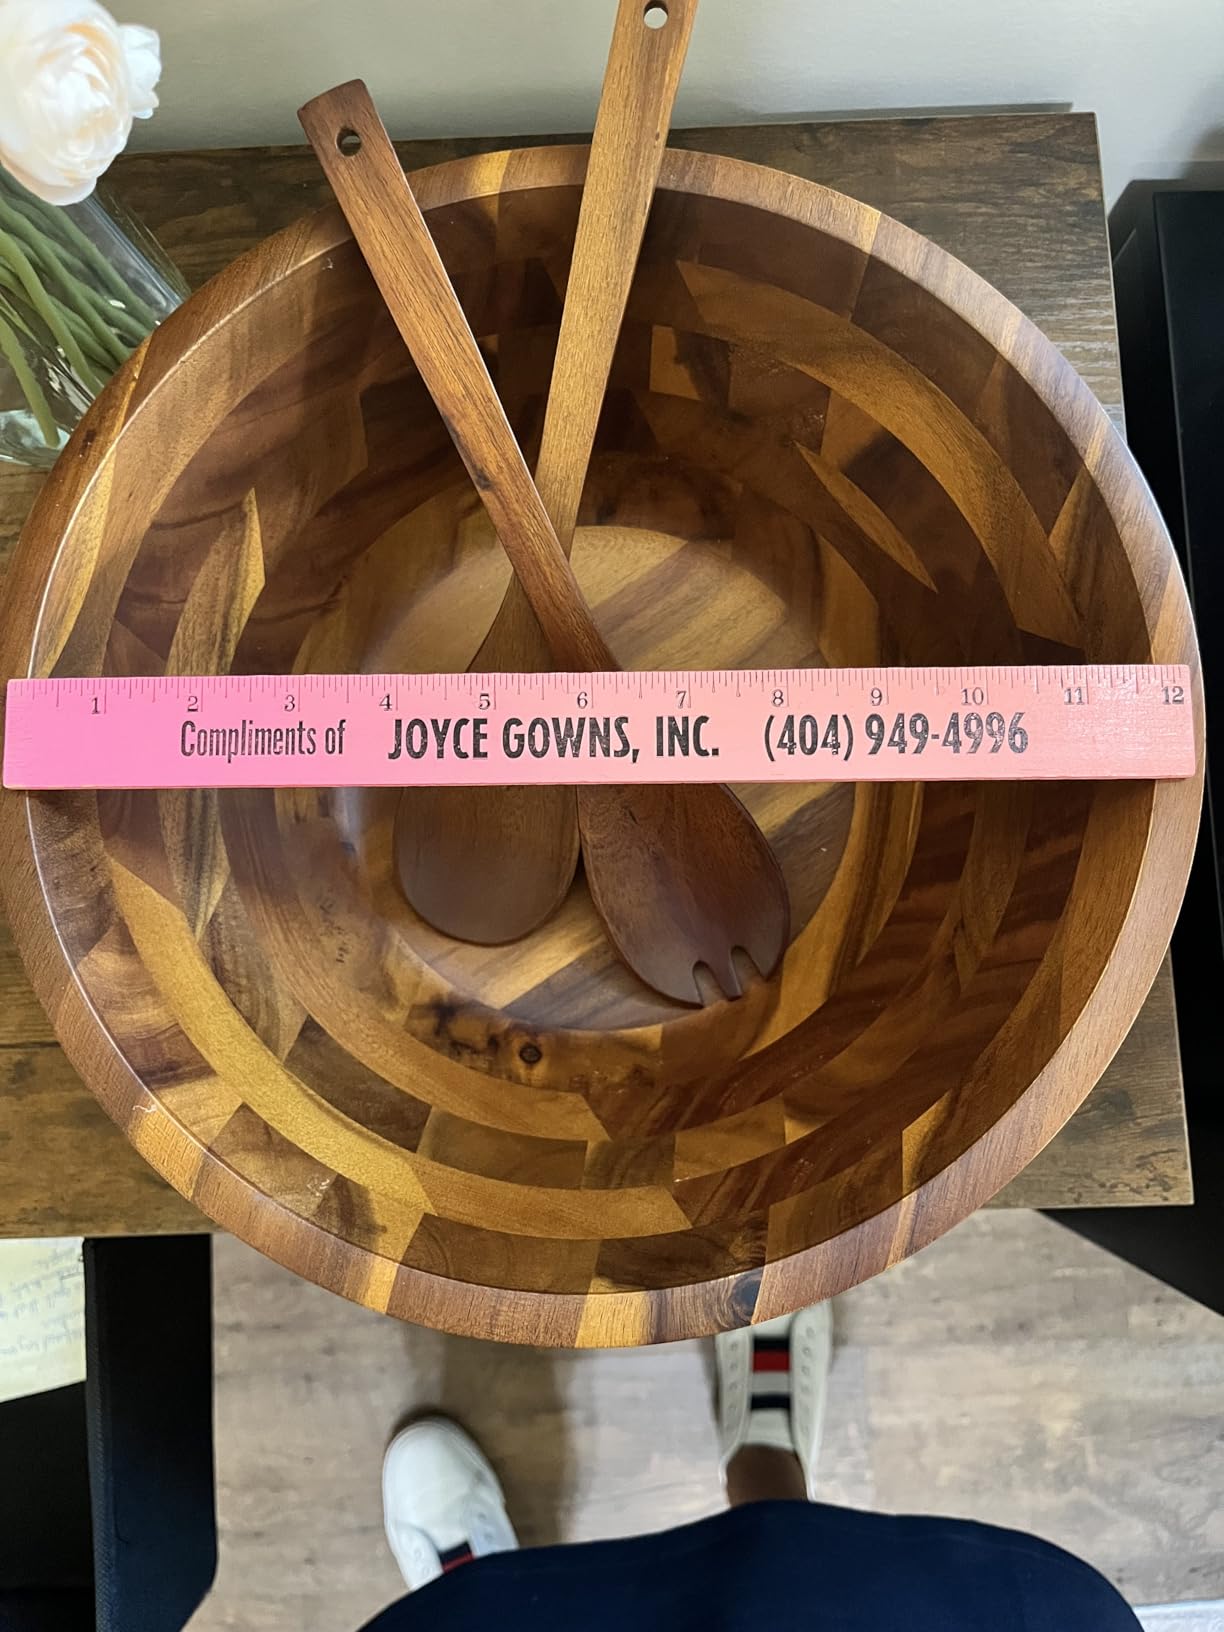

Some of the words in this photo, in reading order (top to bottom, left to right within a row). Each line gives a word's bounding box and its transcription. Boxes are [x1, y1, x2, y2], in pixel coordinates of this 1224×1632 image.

[91, 697, 100, 714] 1
[187, 695, 199, 712] 2
[284, 694, 296, 712] 3
[379, 694, 392, 711] 4
[478, 693, 491, 710] 5
[576, 692, 588, 709] 6
[675, 691, 687, 707] 7
[772, 689, 785, 705] 8
[870, 688, 883, 705] 9
[961, 688, 985, 705] 10
[1064, 687, 1084, 704] 11
[1162, 686, 1184, 704] 12
[181, 720, 316, 763] Compliments
[324, 719, 347, 755] of
[388, 717, 488, 760] JOYCE
[502, 716, 640, 763] GOWNS,
[656, 715, 720, 757] INC.
[764, 713, 854, 761] (404)
[865, 711, 1029, 756] 949-4996
